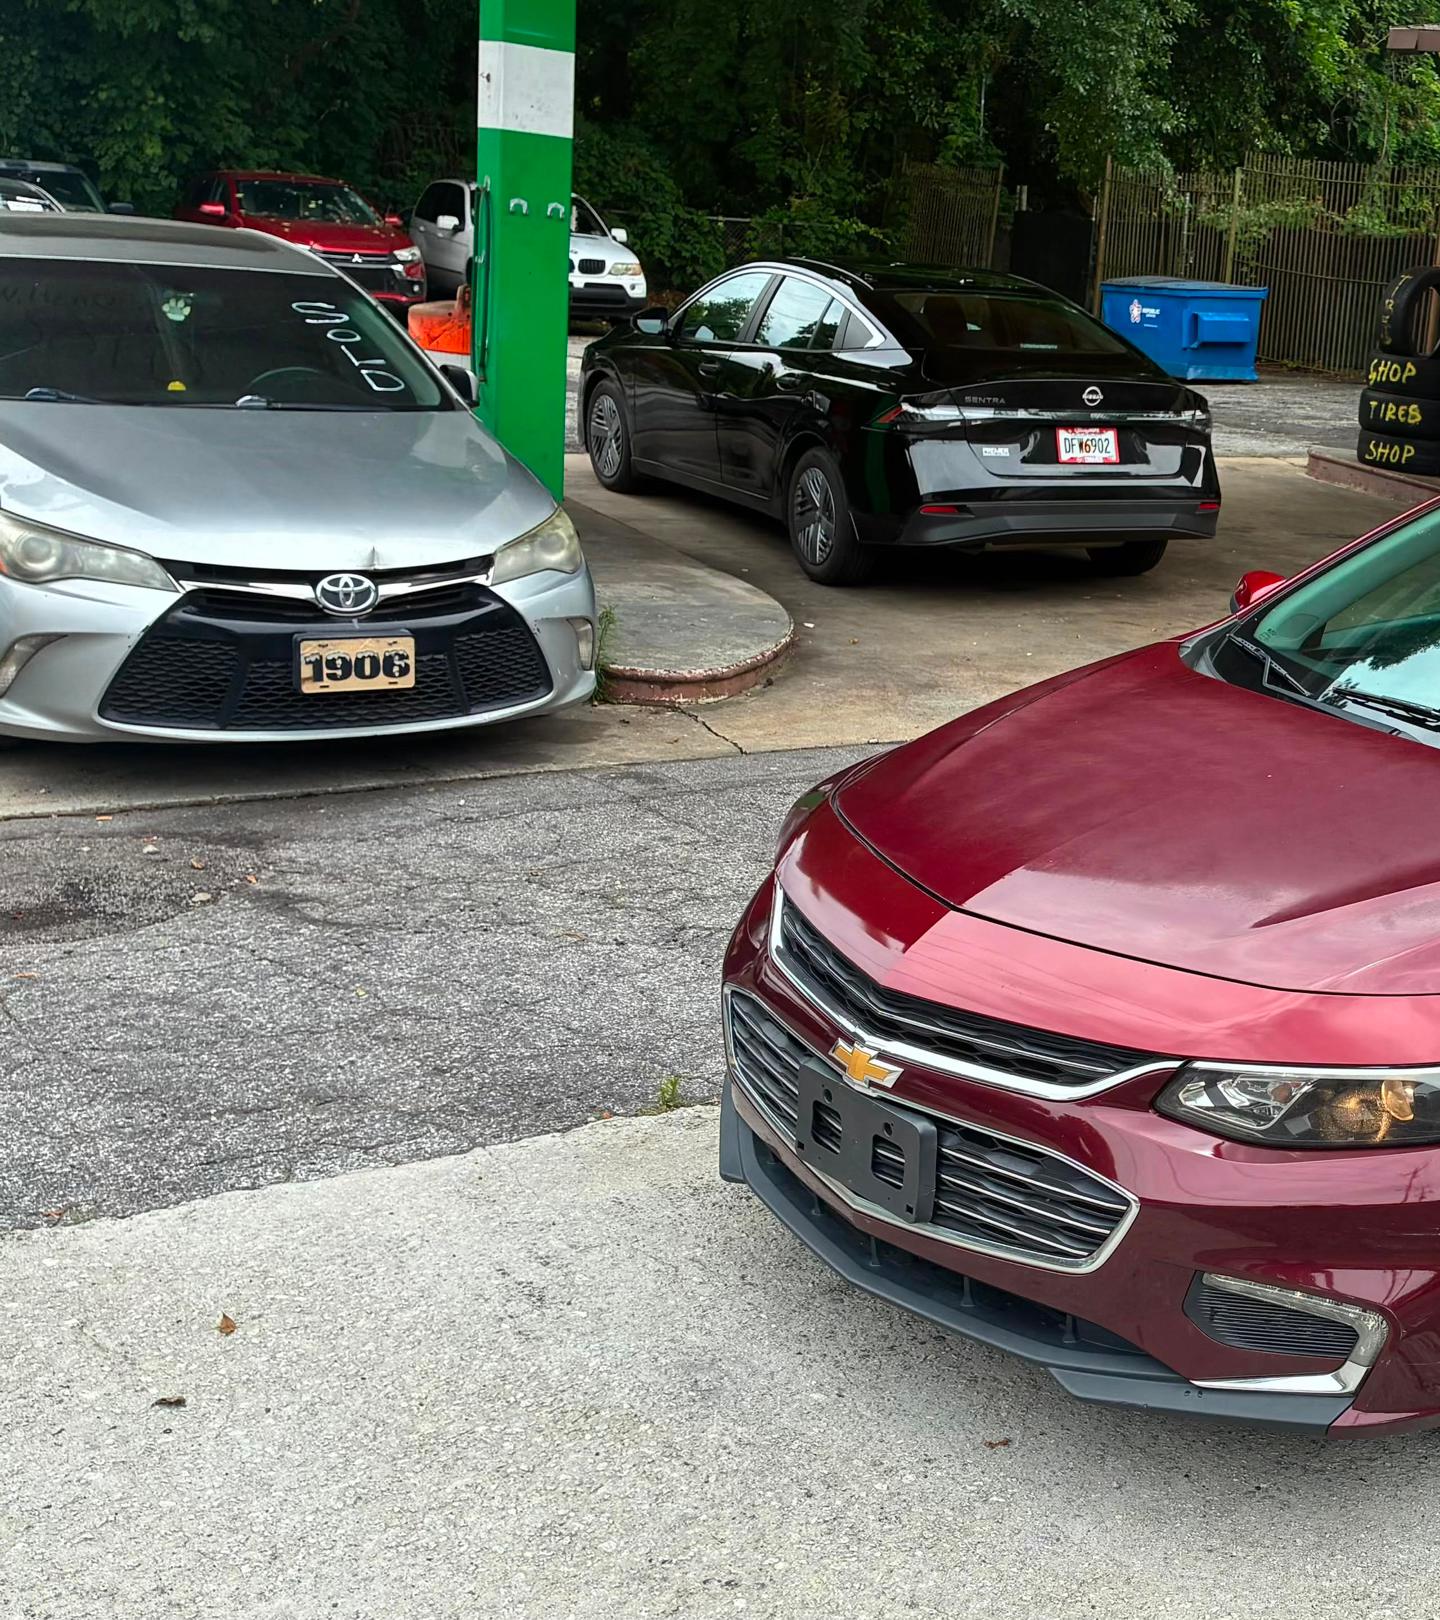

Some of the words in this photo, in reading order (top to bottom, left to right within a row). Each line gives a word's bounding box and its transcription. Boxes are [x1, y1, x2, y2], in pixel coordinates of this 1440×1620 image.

[1368, 358, 1417, 386] SHOP
[964, 396, 1006, 404] SENTRA
[1369, 401, 1422, 425] TIRES
[1365, 440, 1415, 465] SHOP
[304, 649, 410, 682] 1906
